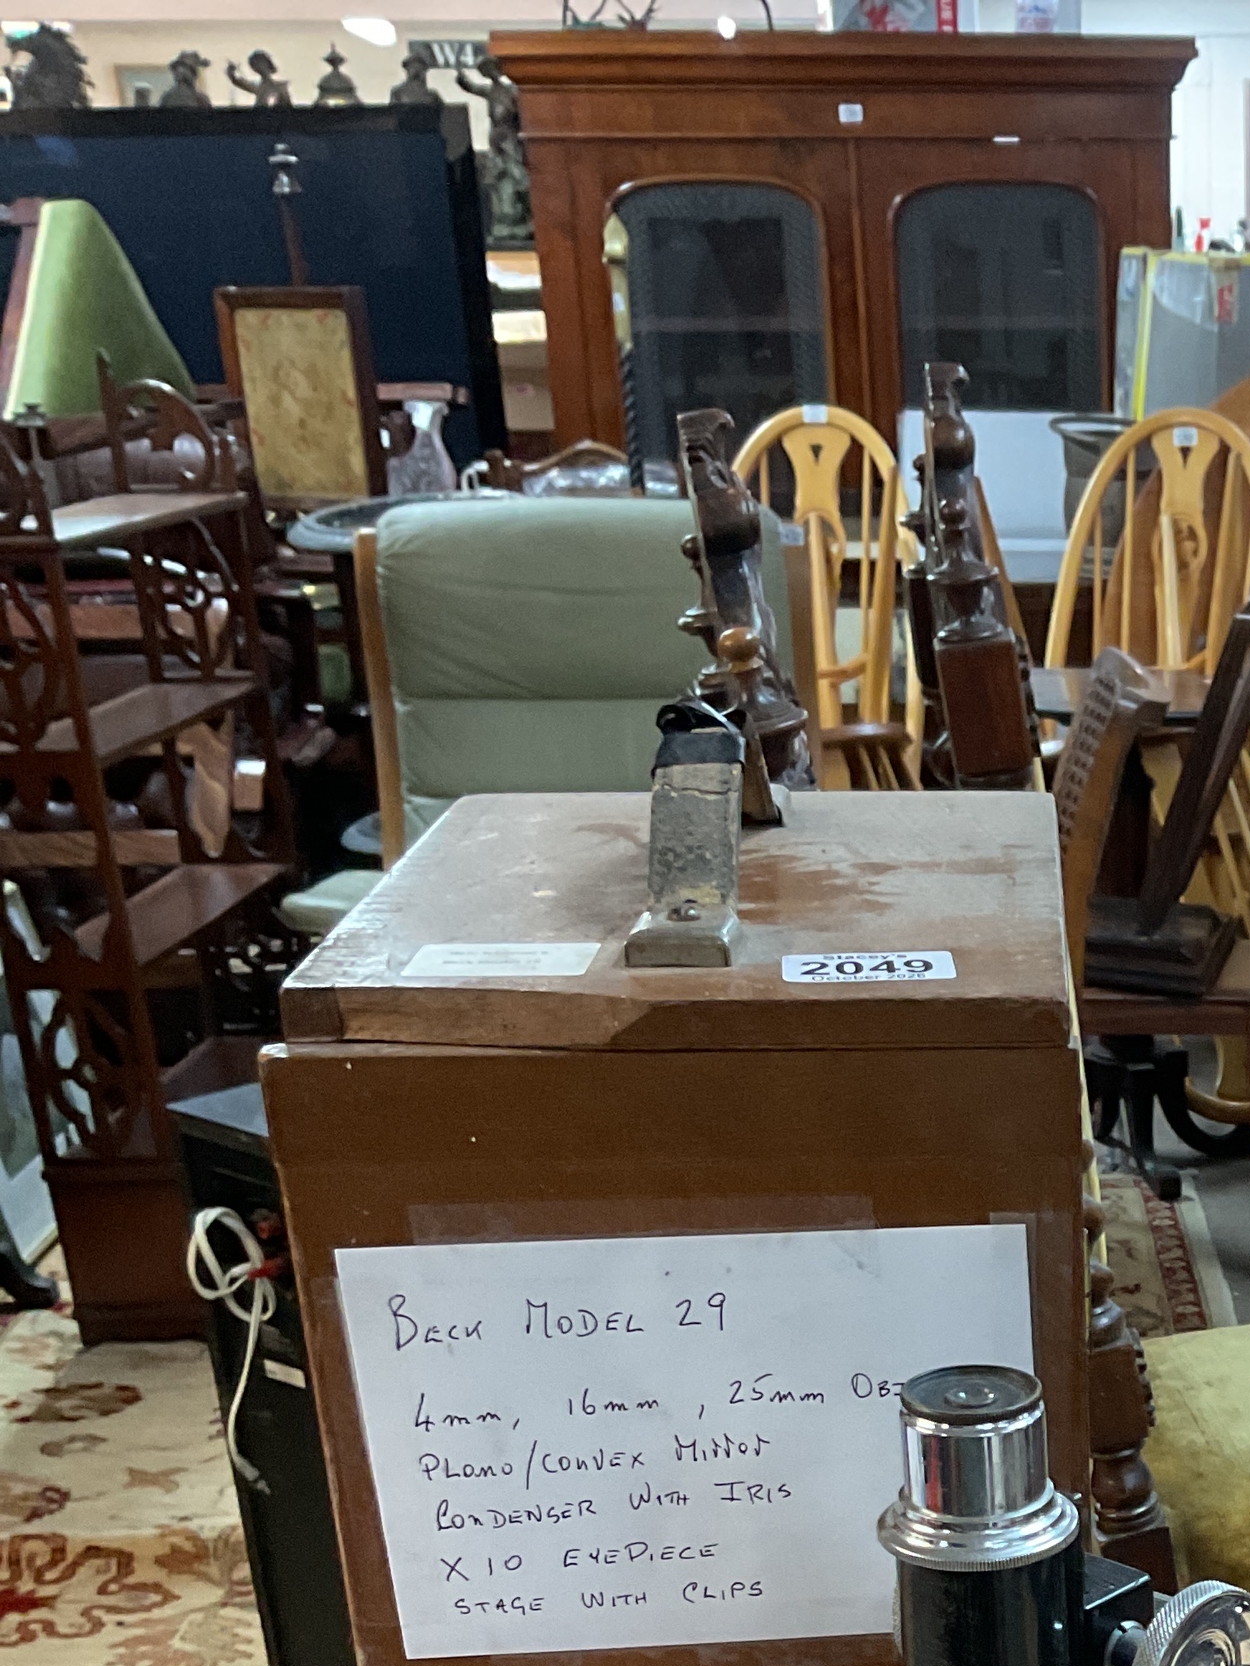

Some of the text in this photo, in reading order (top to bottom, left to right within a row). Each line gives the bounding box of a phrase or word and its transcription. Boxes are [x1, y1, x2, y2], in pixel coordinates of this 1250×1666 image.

[800, 960, 933, 975] 2049
[675, 1291, 727, 1332] 29
[728, 1371, 825, 1405] 25mm
[454, 1580, 763, 1617] STAGE WITH CLIPS
